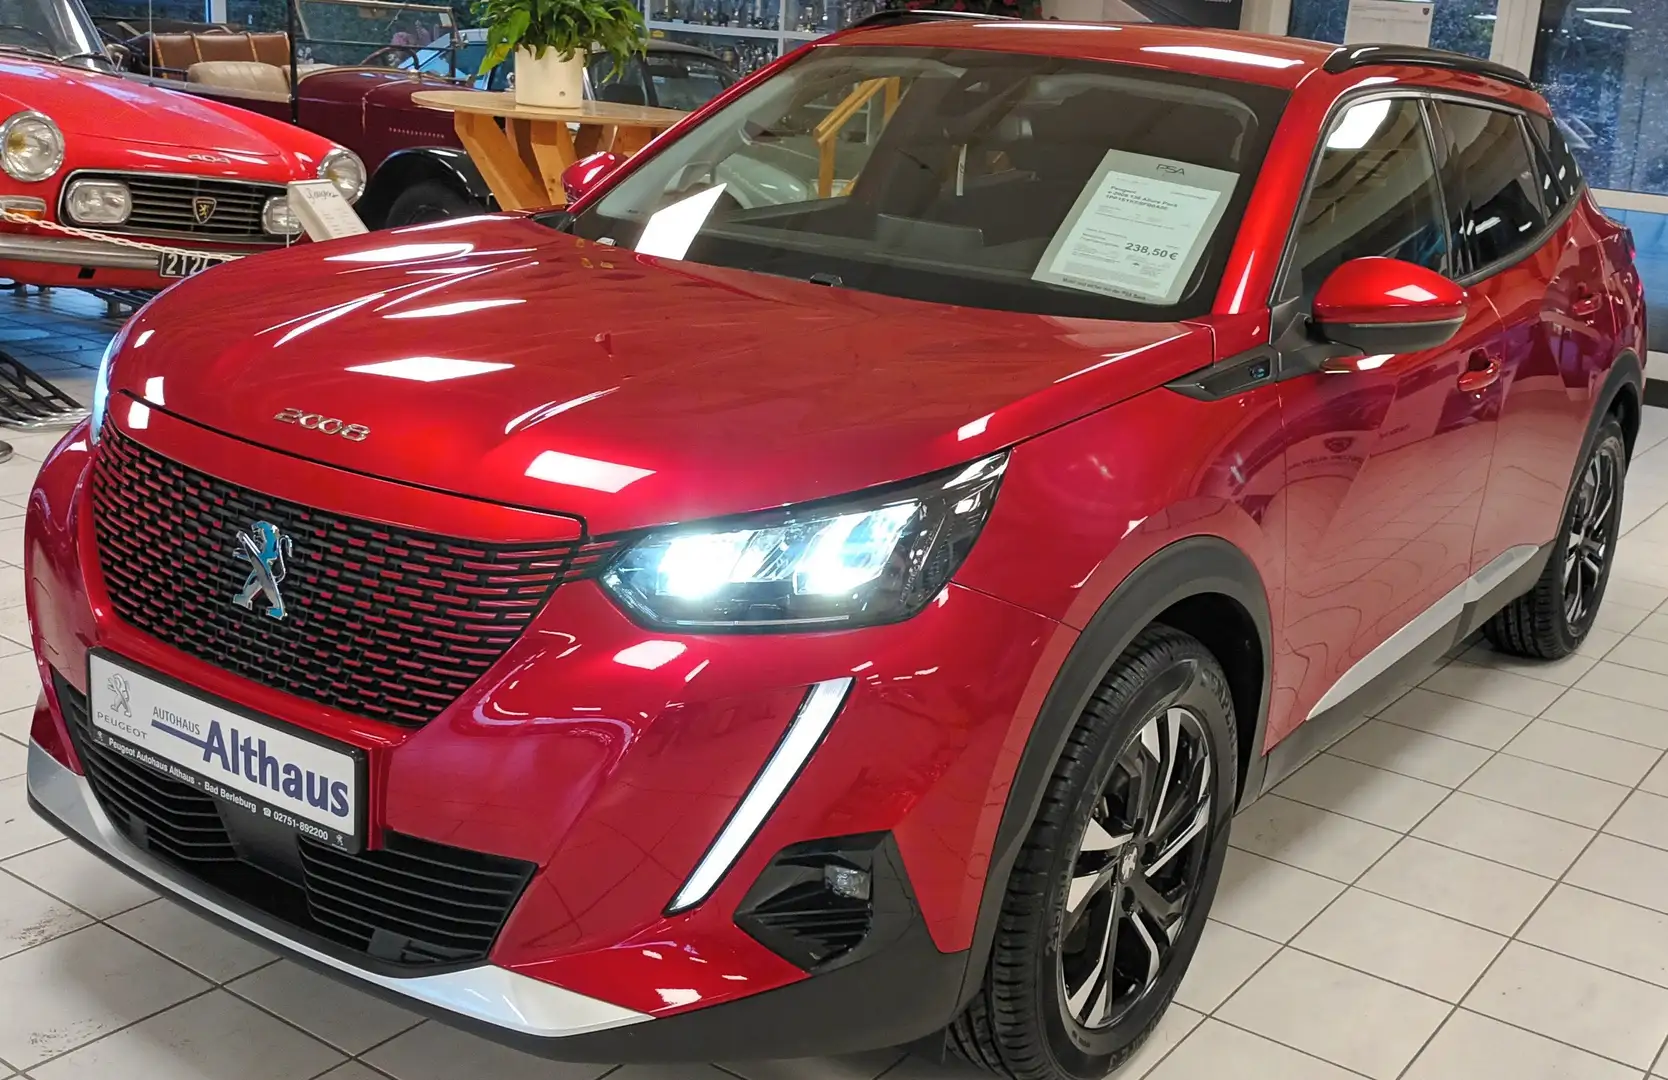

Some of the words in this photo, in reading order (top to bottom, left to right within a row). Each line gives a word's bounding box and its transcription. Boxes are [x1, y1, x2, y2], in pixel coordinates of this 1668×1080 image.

[188, 154, 231, 165] 404
[1156, 163, 1185, 176] PSA
[1125, 242, 1168, 258] 238,50
[1169, 251, 1179, 261] €
[273, 407, 370, 441] 2008
[97, 711, 147, 740] PEUGEOT
[152, 706, 200, 735] AUTOHAUS
[203, 720, 350, 818] Althaus
[108, 737, 136, 758] Peugeot
[136, 750, 168, 772] Autohaus
[169, 766, 195, 785] Althaus
[204, 781, 219, 796] Bad
[220, 788, 257, 814] Berleburg
[273, 811, 329, 841] 02751-892200
